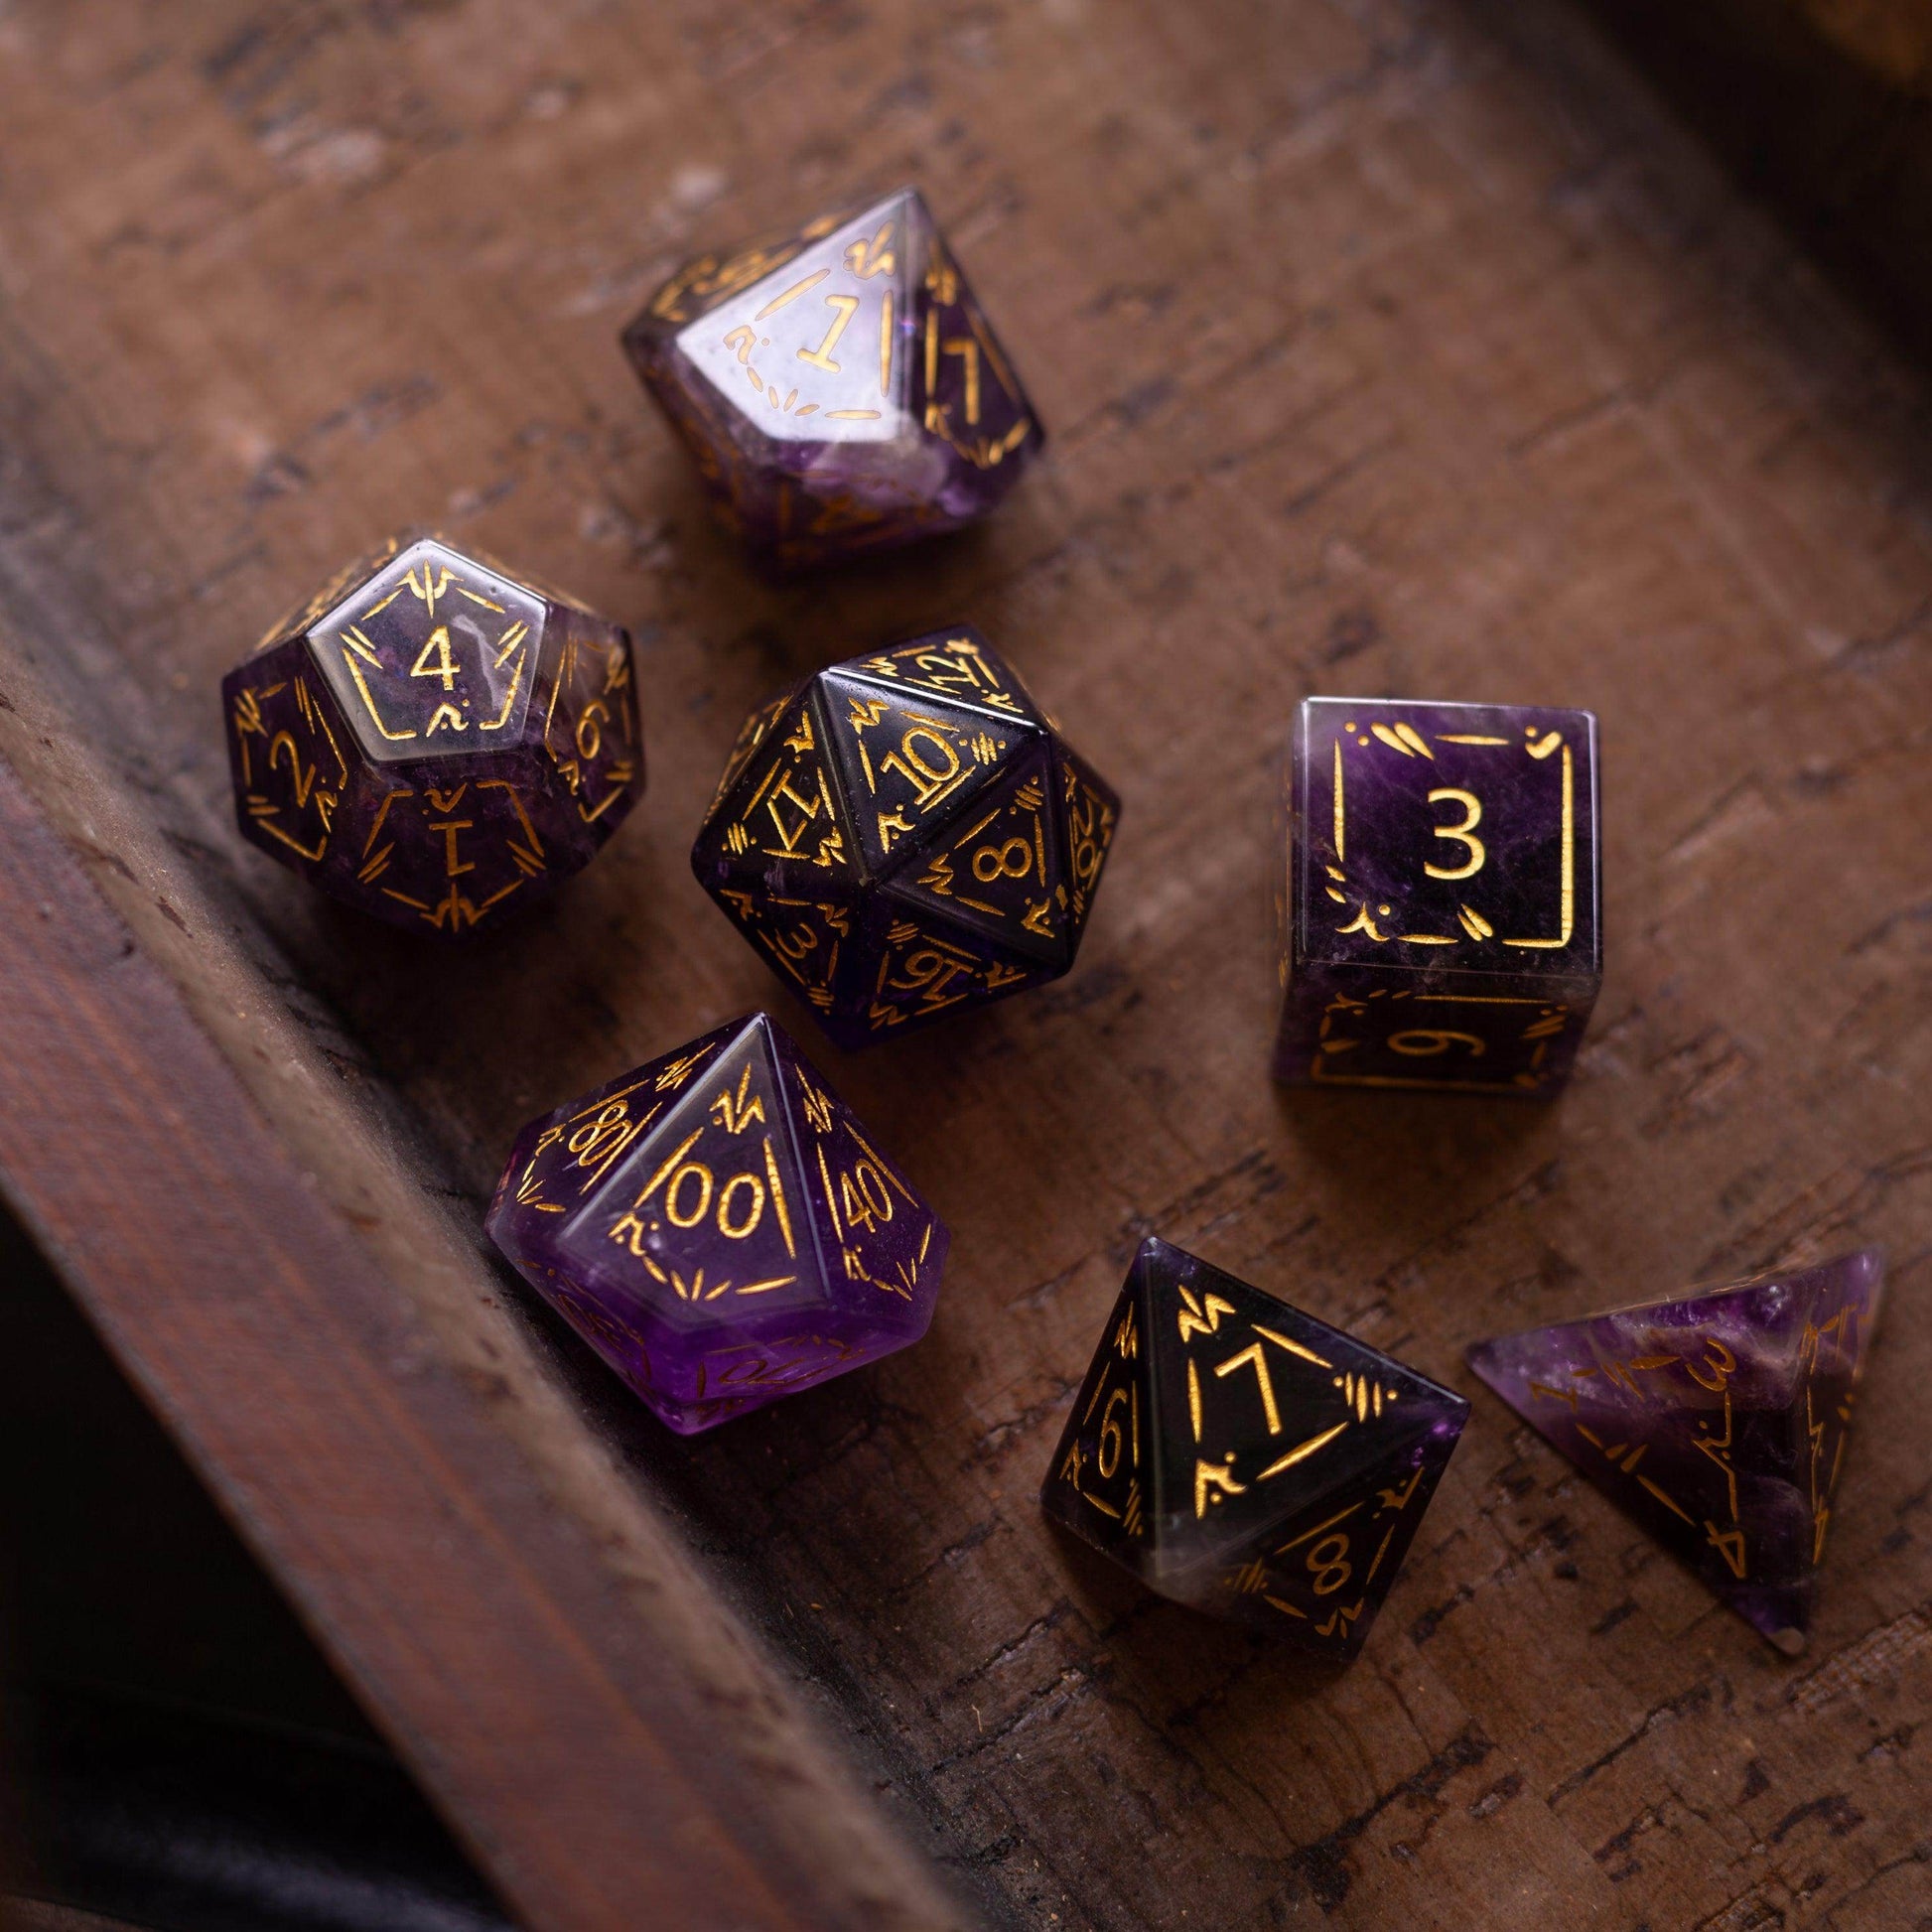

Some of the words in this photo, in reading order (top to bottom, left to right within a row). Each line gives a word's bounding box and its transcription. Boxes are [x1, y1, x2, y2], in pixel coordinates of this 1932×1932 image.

[796, 294, 860, 374] 1
[942, 338, 980, 426] 7
[409, 624, 461, 691] 4
[914, 653, 982, 689] 12
[575, 698, 610, 759] 6
[269, 729, 316, 809] 2
[880, 726, 960, 806] 10
[764, 768, 820, 852] 17
[1423, 786, 1487, 881] 3
[428, 818, 477, 878] 1
[971, 836, 1033, 883] 8
[773, 920, 818, 960] 3
[889, 948, 974, 1002] 16
[1387, 1029, 1487, 1057] 6
[567, 1098, 632, 1168] 80
[663, 1161, 766, 1240] 00
[839, 1158, 895, 1234] 40
[1212, 1340, 1284, 1437] 7
[1684, 1336, 1736, 1392] 3
[1097, 1387, 1129, 1479] 6
[1305, 1532, 1353, 1595] 8
[1703, 1519, 1746, 1579] 4
